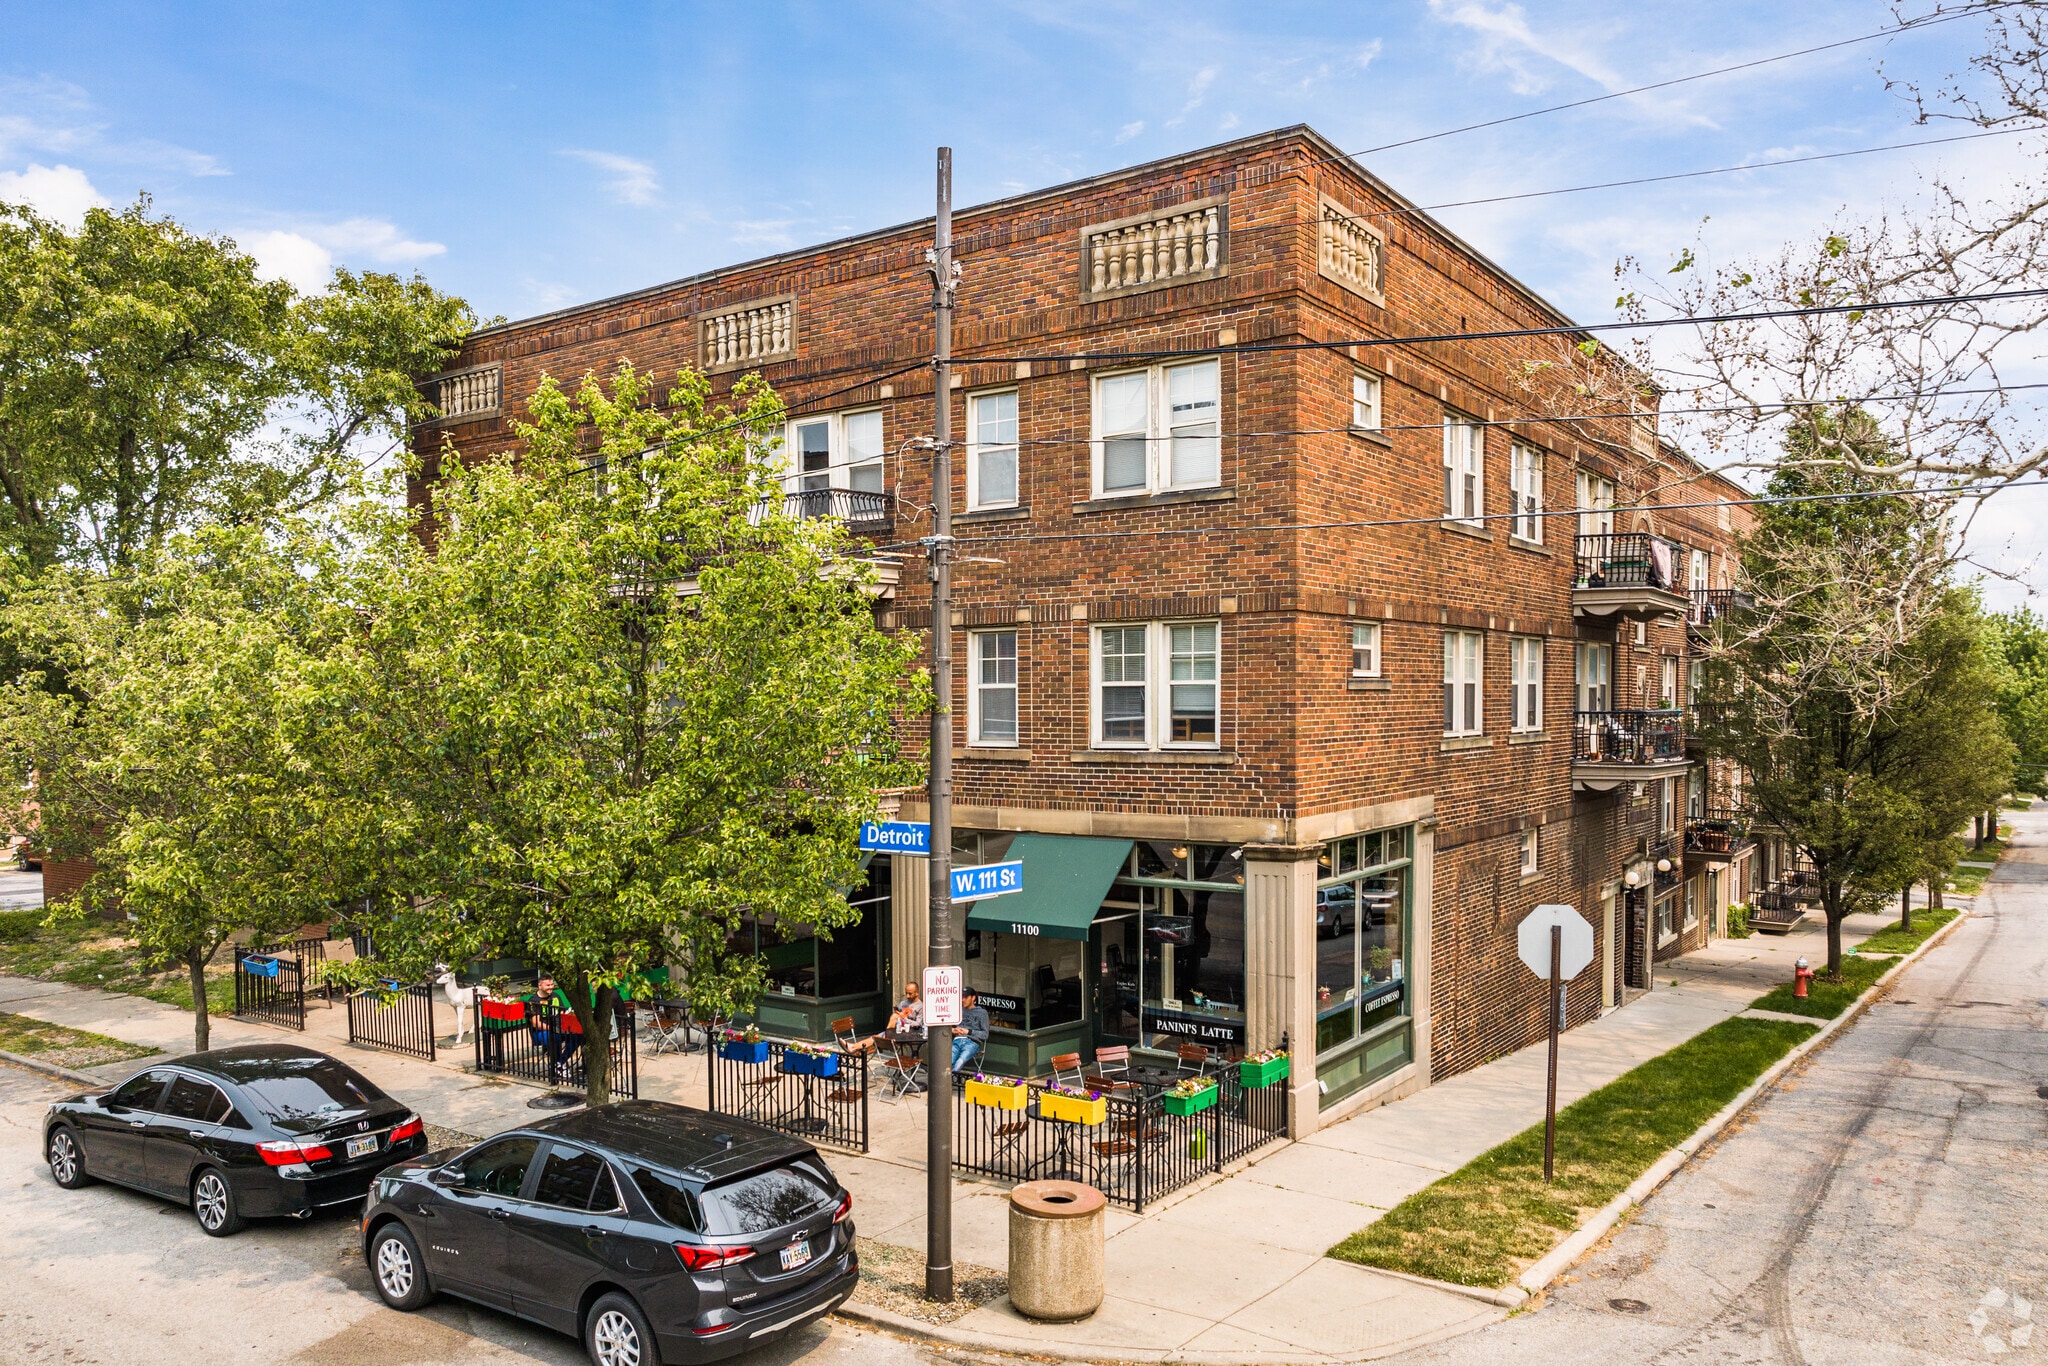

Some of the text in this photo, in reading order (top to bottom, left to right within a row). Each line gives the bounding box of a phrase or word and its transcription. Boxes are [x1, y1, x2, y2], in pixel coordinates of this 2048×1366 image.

[867, 825, 924, 846] Detroit
[956, 868, 1016, 893] W. 111 St
[1011, 923, 1040, 936] 11100
[935, 975, 950, 986] NO
[927, 986, 958, 995] PARKING
[935, 996, 949, 1004] ANY
[977, 995, 1016, 1010] ESPRESSO
[1365, 989, 1400, 1013] COFFEE ESPRESSO
[935, 1005, 950, 1013] TIME
[1156, 1019, 1234, 1040] PANINI'S LATTE
